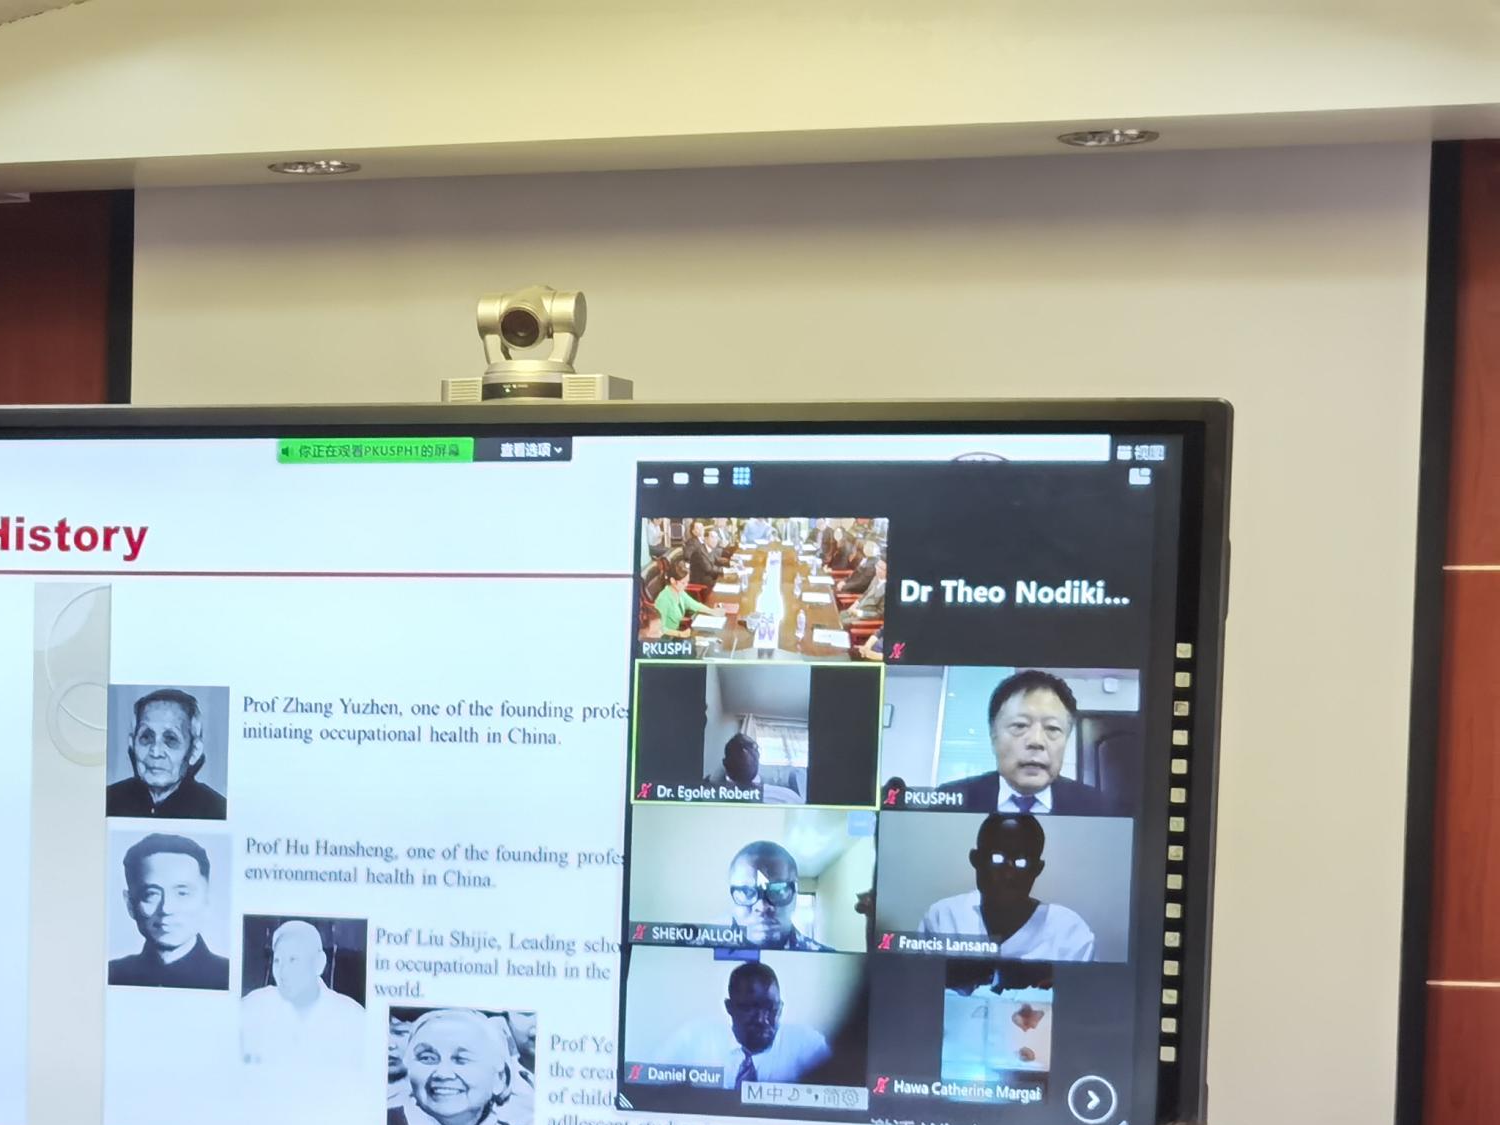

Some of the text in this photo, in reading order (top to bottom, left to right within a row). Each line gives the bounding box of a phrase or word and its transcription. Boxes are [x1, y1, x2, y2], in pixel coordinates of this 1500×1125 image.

[901, 581, 933, 603] Dr
[940, 580, 1006, 604] Theo
[642, 641, 692, 656] PKUSPH
[243, 696, 278, 715] Prof
[282, 697, 333, 718] Zhang
[339, 697, 403, 717] Yuzhen,
[411, 703, 440, 716] one
[445, 699, 465, 717] of
[469, 700, 493, 717] the
[500, 700, 574, 720] founding
[242, 724, 561, 745] initiating occupational health in China.
[657, 784, 761, 802] Dr. Egolet Robert
[904, 790, 964, 807] PKUSPH1
[246, 838, 279, 856] Prof
[285, 838, 309, 856] Hu
[315, 839, 398, 861] Hansheng,
[406, 846, 436, 860] one
[441, 842, 460, 860] of
[465, 843, 490, 861] the
[496, 844, 569, 867] founding
[245, 864, 497, 888] environmental health in China.
[375, 928, 410, 945] Prof
[416, 929, 444, 947] Liu
[450, 931, 502, 951] Shijie,
[509, 933, 576, 955] Leading
[652, 926, 743, 943] SHEKU JALLOH
[899, 936, 998, 954] Francis Lansana
[375, 955, 610, 979] in occupational health in the
[374, 980, 425, 998] world.
[551, 1034, 587, 1052] Prof
[550, 1062, 574, 1078] the
[648, 1067, 721, 1083] Daniel Odur
[547, 1086, 616, 1107] of child
[894, 1080, 929, 1096] Hawa
[932, 1081, 993, 1099] Catherine
